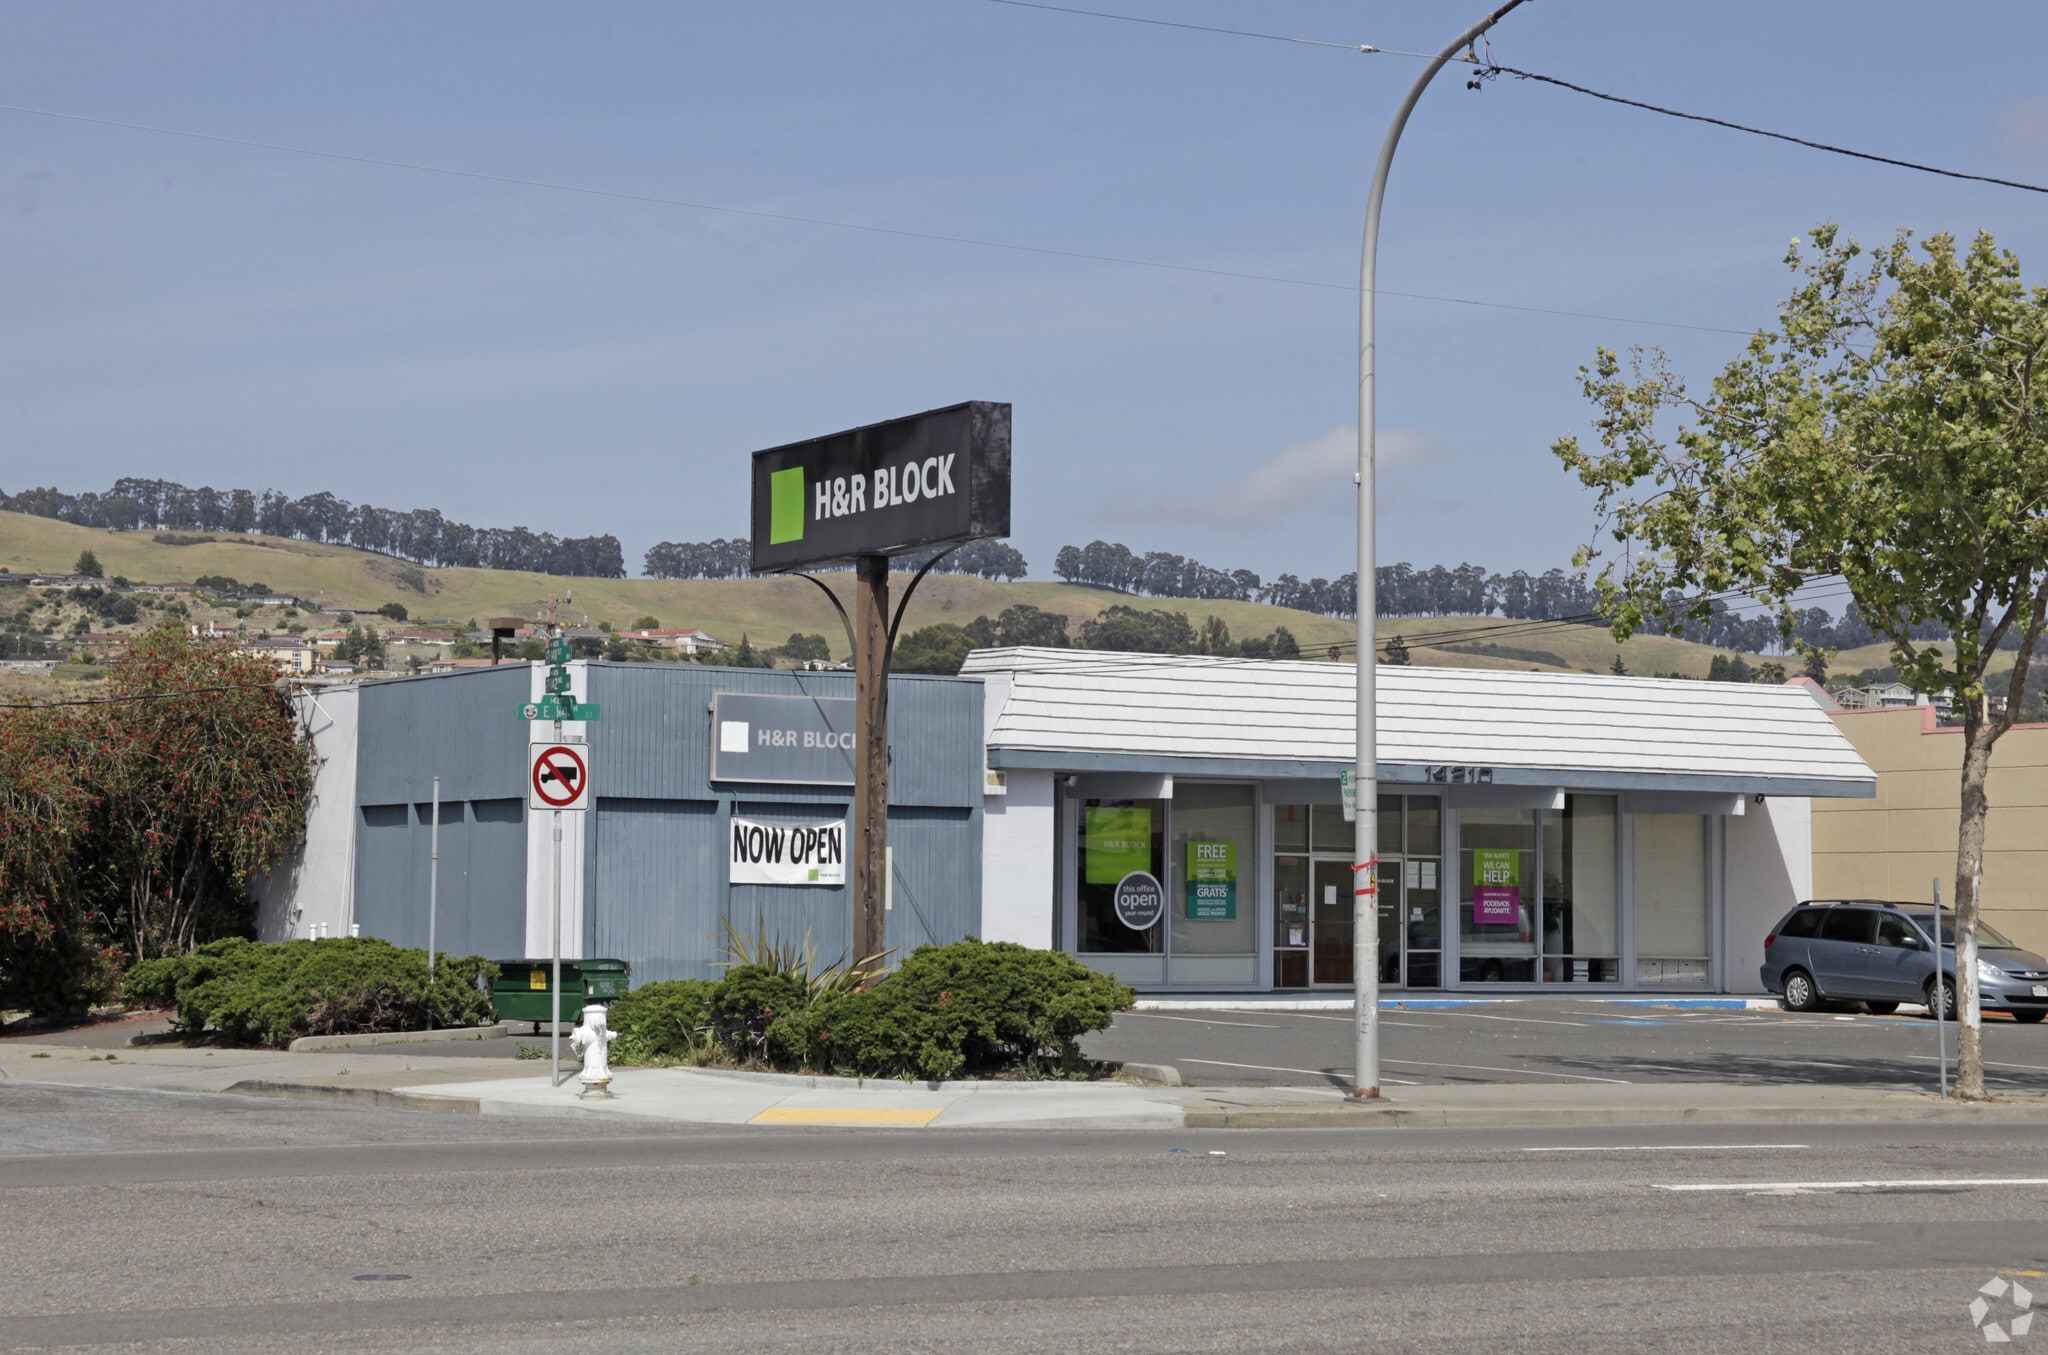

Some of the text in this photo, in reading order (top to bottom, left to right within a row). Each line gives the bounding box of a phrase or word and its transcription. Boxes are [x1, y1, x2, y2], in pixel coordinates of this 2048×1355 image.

[815, 453, 956, 520] H&R BLOCK
[758, 729, 797, 747] H&R
[1424, 764, 1493, 784] 14210
[734, 825, 842, 864] NOW OPEN
[1103, 840, 1147, 849] H&R BLOCK
[1197, 844, 1226, 858] FREE
[1483, 861, 1510, 870] WE CAN
[1123, 884, 1155, 893] this office
[1197, 888, 1227, 898] GRATIS
[1120, 894, 1157, 910] open
